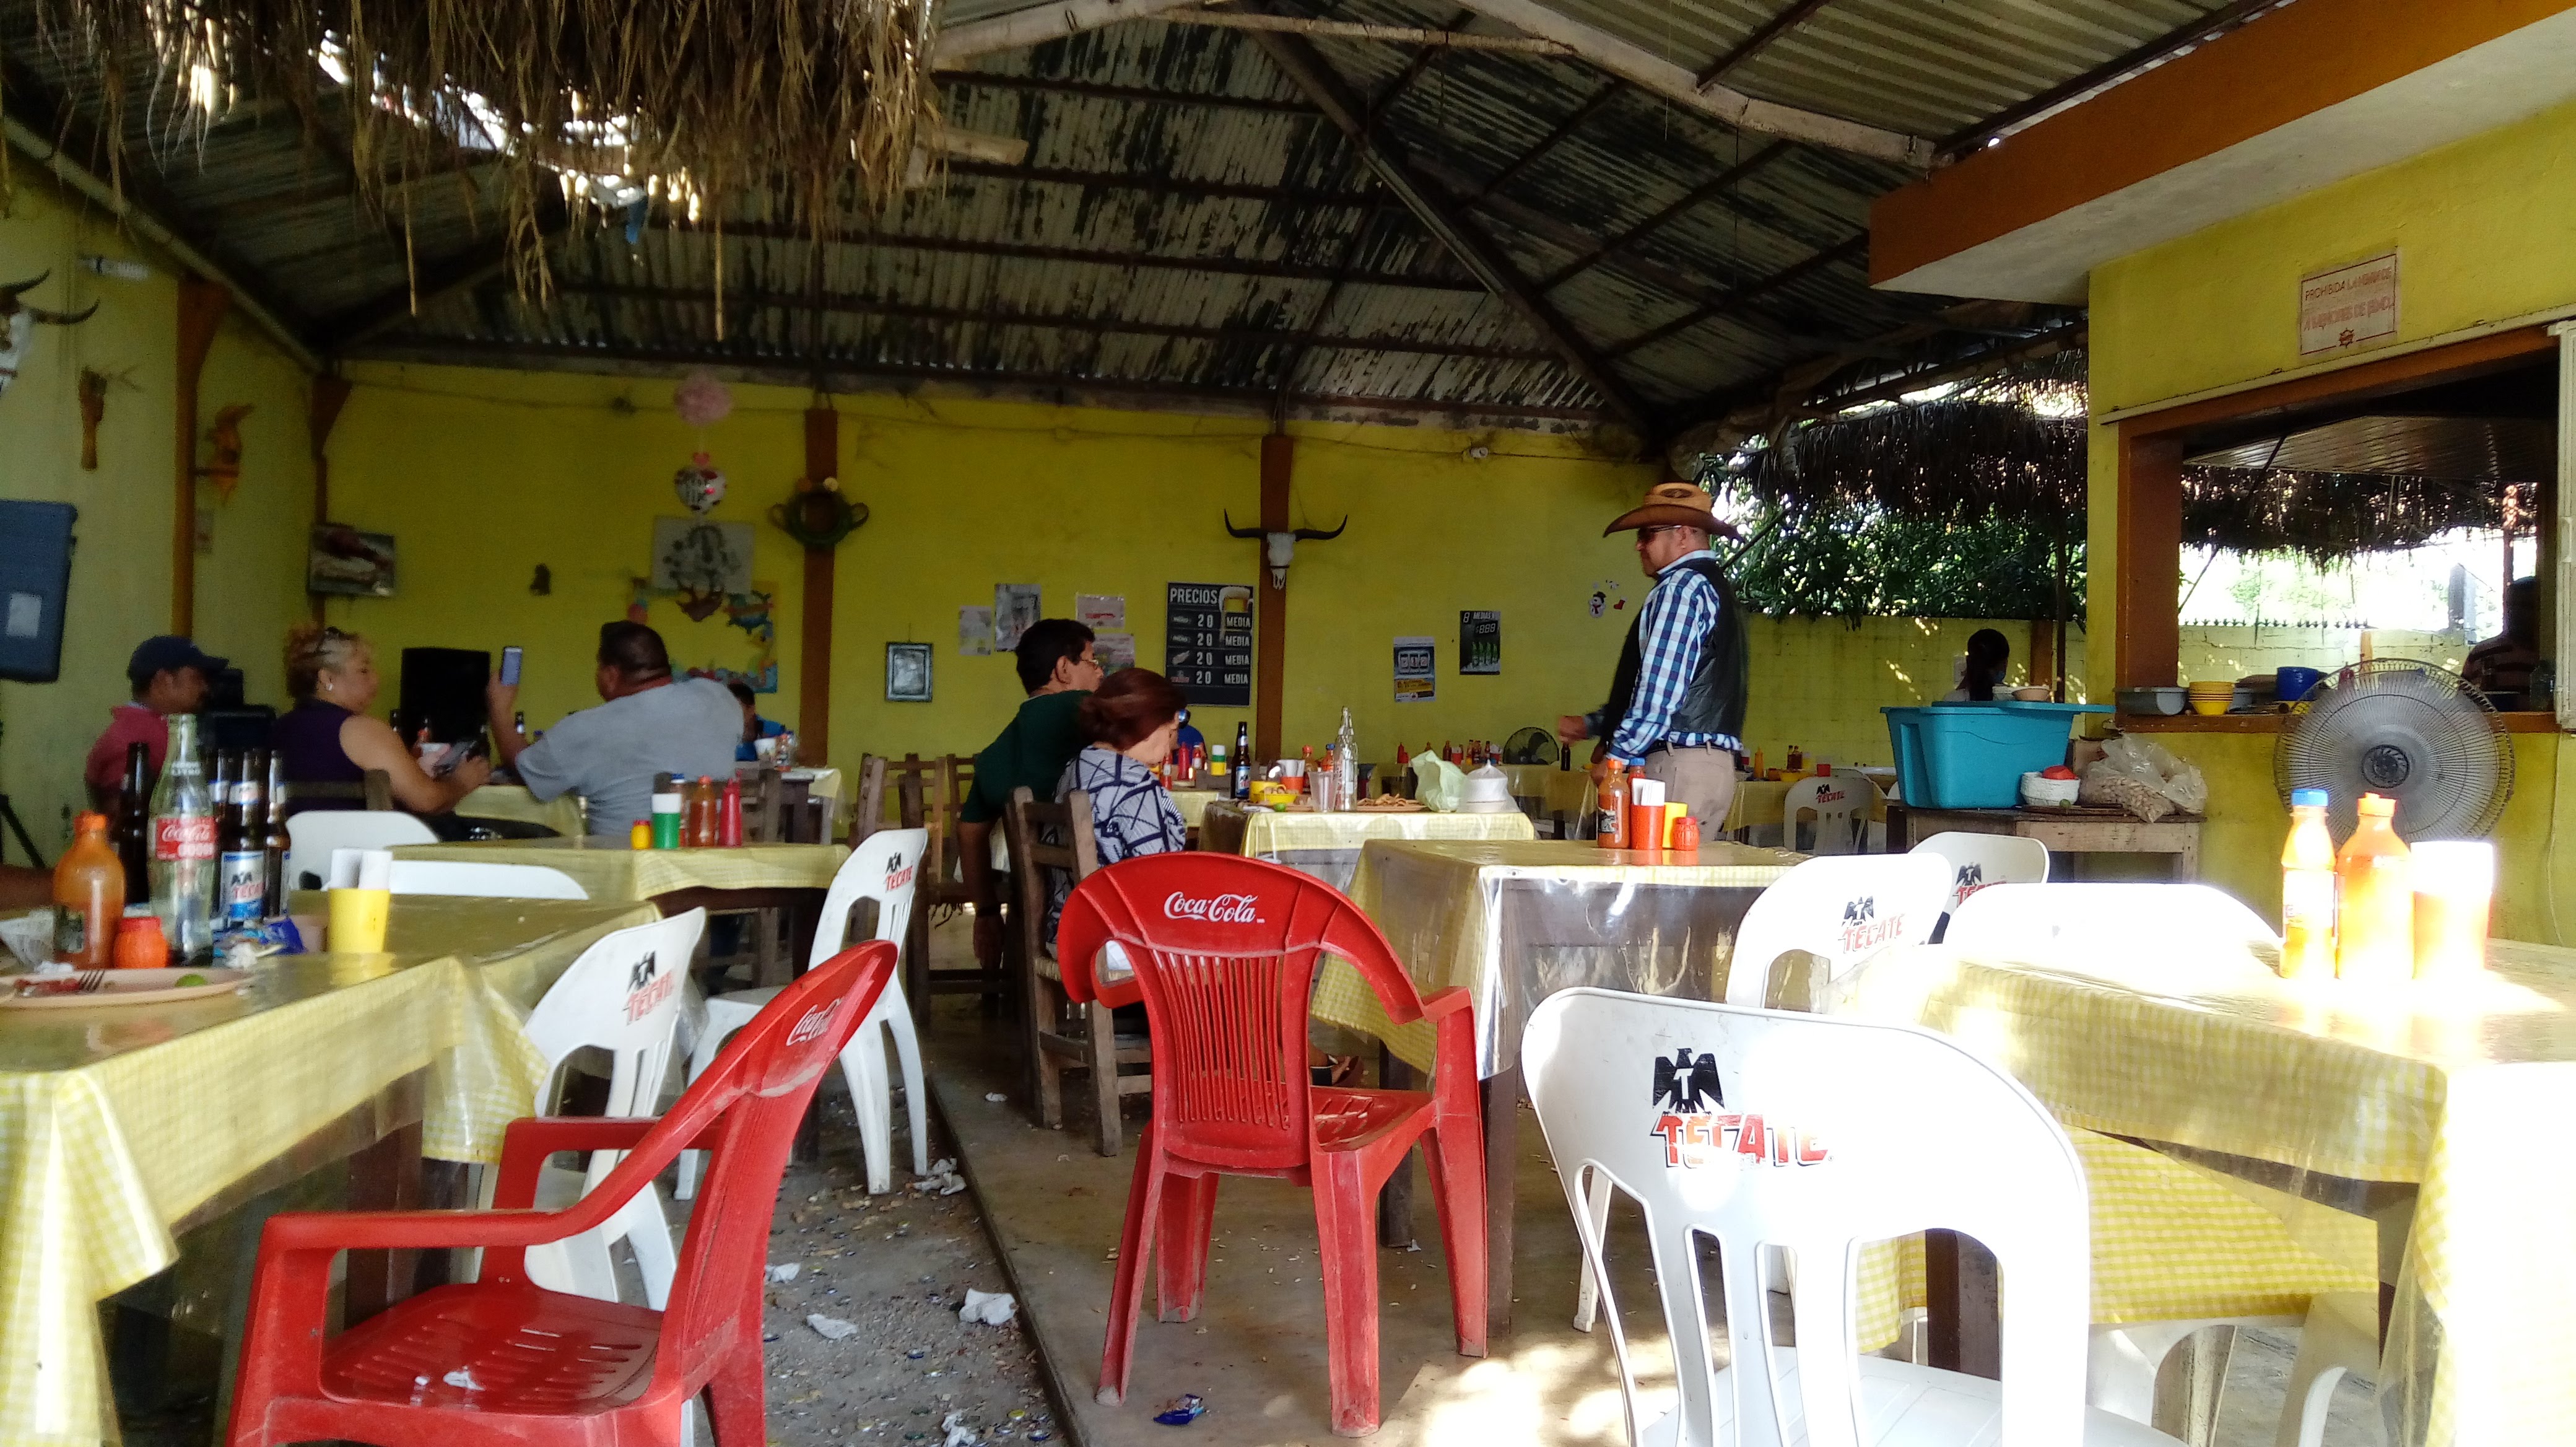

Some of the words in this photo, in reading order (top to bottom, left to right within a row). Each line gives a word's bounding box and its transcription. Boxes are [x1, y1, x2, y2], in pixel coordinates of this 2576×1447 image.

[1170, 588, 1218, 605] PRECIOS
[1198, 614, 1214, 628] 20
[1226, 617, 1250, 627] MEDIA
[1197, 632, 1212, 647] 20
[1225, 636, 1250, 647] MEDIA
[1196, 652, 1212, 666] 20
[1225, 655, 1250, 666] MEDIA
[1196, 670, 1211, 684] 20
[1224, 673, 1248, 684] MEDIA
[1816, 790, 1845, 804] TECATE
[1164, 891, 1258, 923] Coca-Cola
[1838, 914, 1905, 954] TECATE
